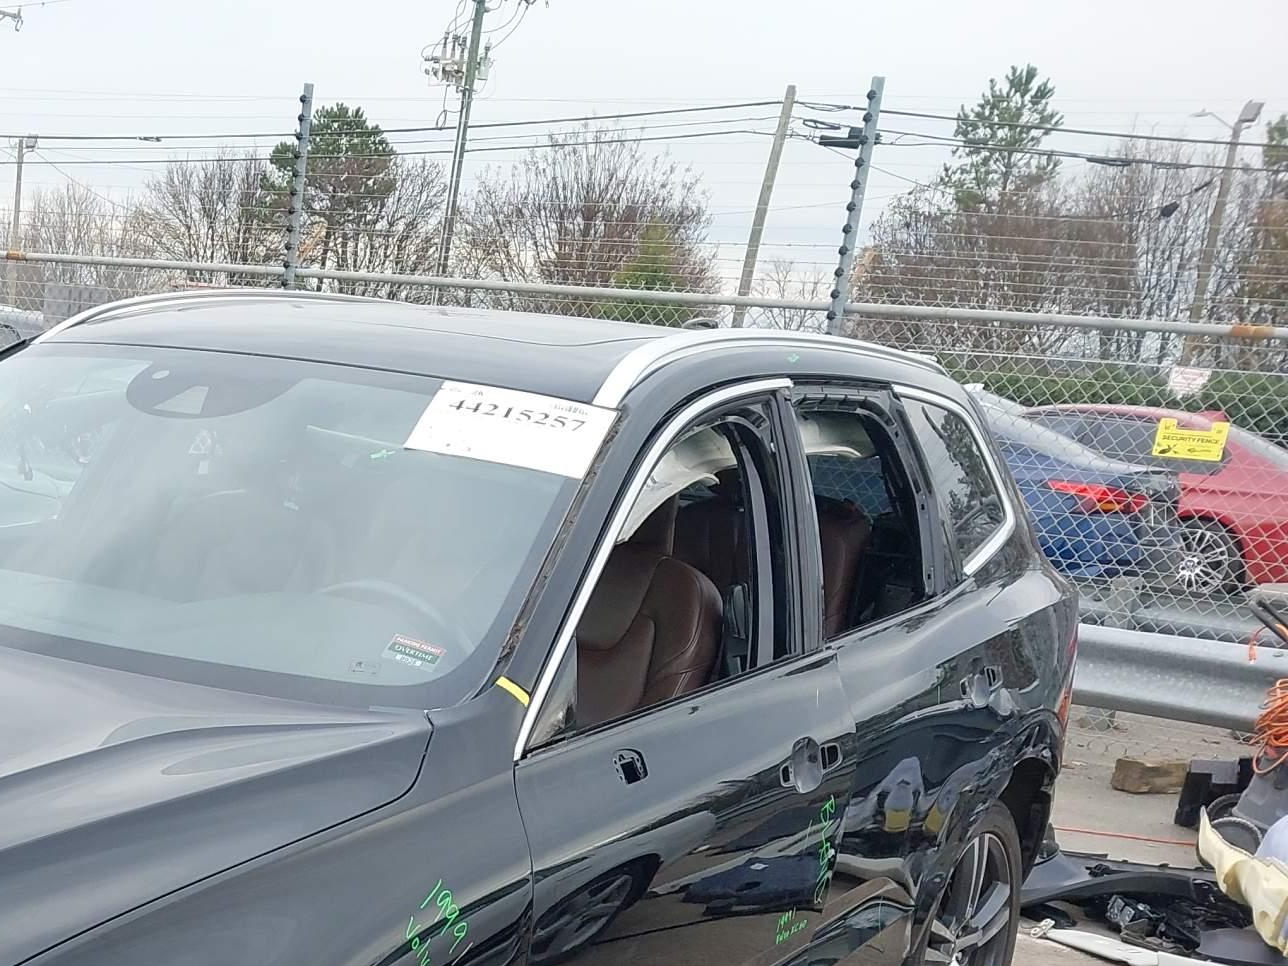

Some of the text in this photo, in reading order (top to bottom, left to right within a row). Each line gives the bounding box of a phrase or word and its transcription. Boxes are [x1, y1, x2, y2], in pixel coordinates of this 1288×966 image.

[448, 399, 586, 432] 44215257
[1162, 434, 1195, 444] SECURITY
[394, 644, 433, 661] OVERTIME
[420, 878, 474, 966] 19991
